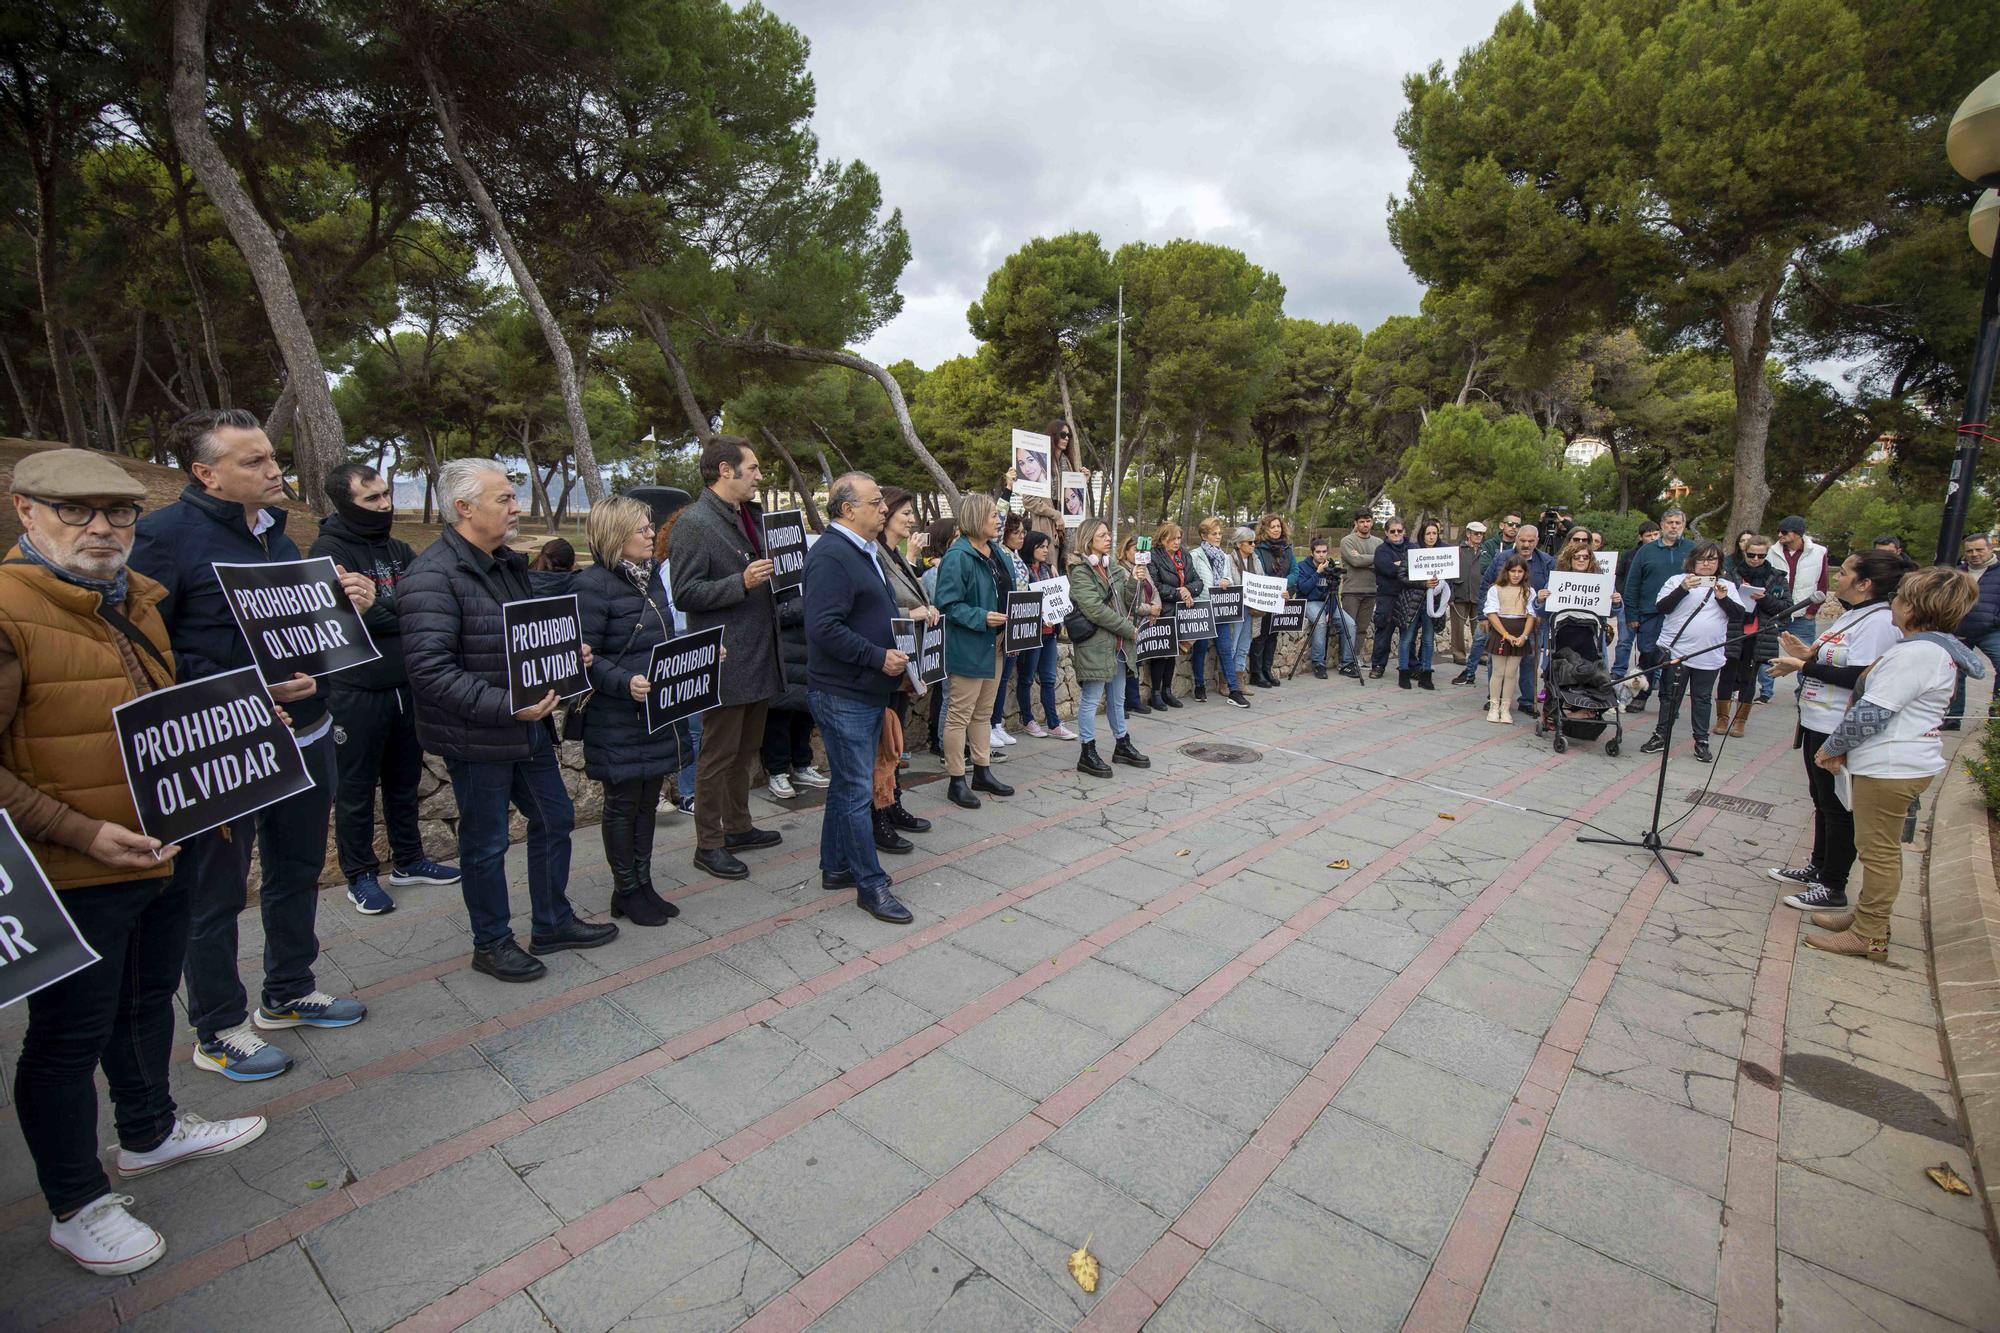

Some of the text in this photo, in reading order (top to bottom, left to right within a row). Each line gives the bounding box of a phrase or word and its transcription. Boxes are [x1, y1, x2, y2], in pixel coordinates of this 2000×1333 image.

[767, 525, 802, 550] PROHIBIDO
[773, 550, 804, 576] OLVIDAR
[1258, 590, 1279, 598] silencio
[1558, 581, 1601, 594] ¿Porqué
[233, 581, 337, 620] PROHIBIDO
[1010, 602, 1040, 619] PROHIBIDO
[1049, 595, 1064, 607] está
[1558, 595, 1600, 607] mi hija?
[1047, 609, 1057, 621] mi
[1177, 608, 1209, 620] PROHIBIDO
[511, 615, 576, 653] PROHIBIDO
[1012, 622, 1038, 640] OLVIDAR
[1179, 621, 1210, 634] OLVIDAR
[262, 619, 350, 660] OLVIDAR
[1136, 639, 1170, 655] OLVIDAR
[521, 650, 579, 688] OLVIDAR
[653, 644, 715, 683] PROHIBIDO
[659, 673, 711, 710] OLVIDAR
[133, 695, 272, 773] PROHIBIDO
[156, 742, 281, 816] OLVIDAR
